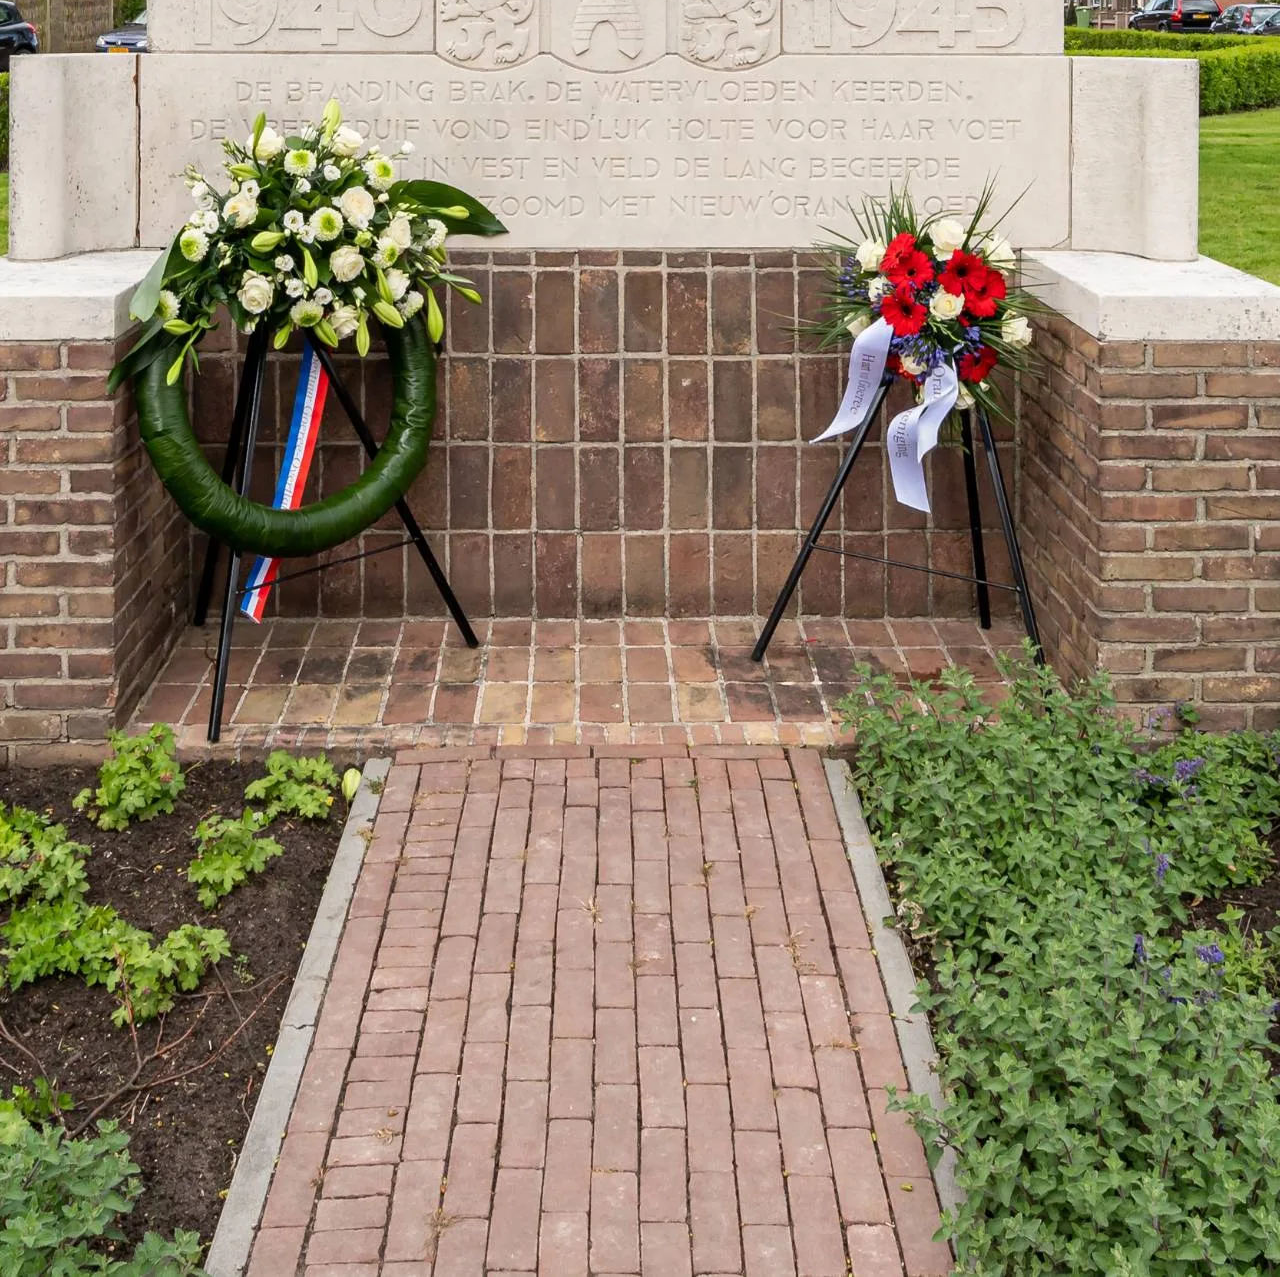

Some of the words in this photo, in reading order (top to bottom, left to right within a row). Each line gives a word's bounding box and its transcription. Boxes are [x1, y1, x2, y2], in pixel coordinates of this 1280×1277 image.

[235, 80, 272, 102] DE
[286, 80, 434, 102] BRANDING
[449, 80, 535, 102] BRAK.
[545, 80, 582, 102] DE
[594, 80, 817, 102] WATERVLOEDEN
[832, 80, 974, 102] KEERDEN.
[191, 119, 227, 140] DE
[432, 119, 511, 140] VOND
[667, 119, 755, 140] HOLTE
[767, 119, 847, 140] VOOR
[862, 119, 934, 140] HAAR
[948, 119, 1022, 140] VOET
[423, 157, 449, 179] IN
[461, 157, 531, 179] VEST
[543, 157, 580, 179] EN
[591, 157, 661, 179] VELD
[674, 157, 711, 179] DE
[722, 157, 796, 179] LANG
[809, 157, 960, 179] BEGEERDE
[478, 196, 586, 217] ZOOMD
[599, 196, 657, 217] MET
